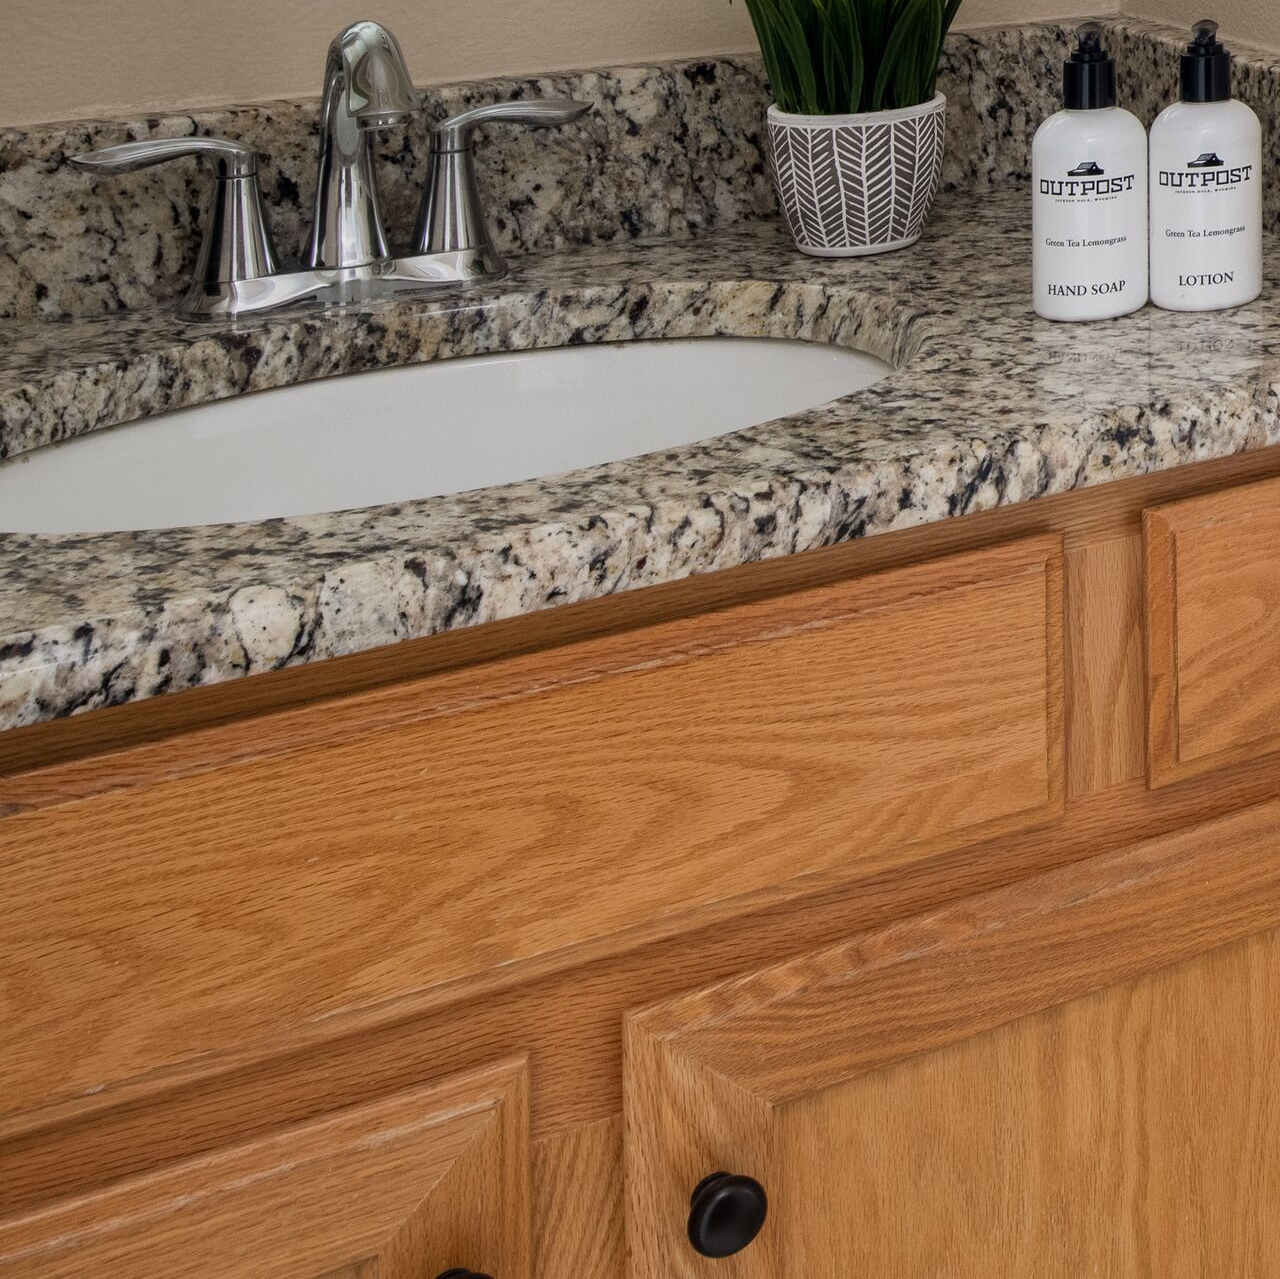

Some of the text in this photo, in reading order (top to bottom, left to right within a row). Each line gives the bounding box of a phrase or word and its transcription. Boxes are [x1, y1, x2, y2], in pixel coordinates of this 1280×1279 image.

[1159, 165, 1252, 187] OUTPOST
[1040, 174, 1135, 196] OUTPOST
[1165, 225, 1246, 238] Green Tea Lemongrass
[1045, 235, 1127, 247] Green Tea Lemongrass
[1178, 271, 1234, 286] LOTION
[1047, 280, 1126, 296] HAND SOAP
